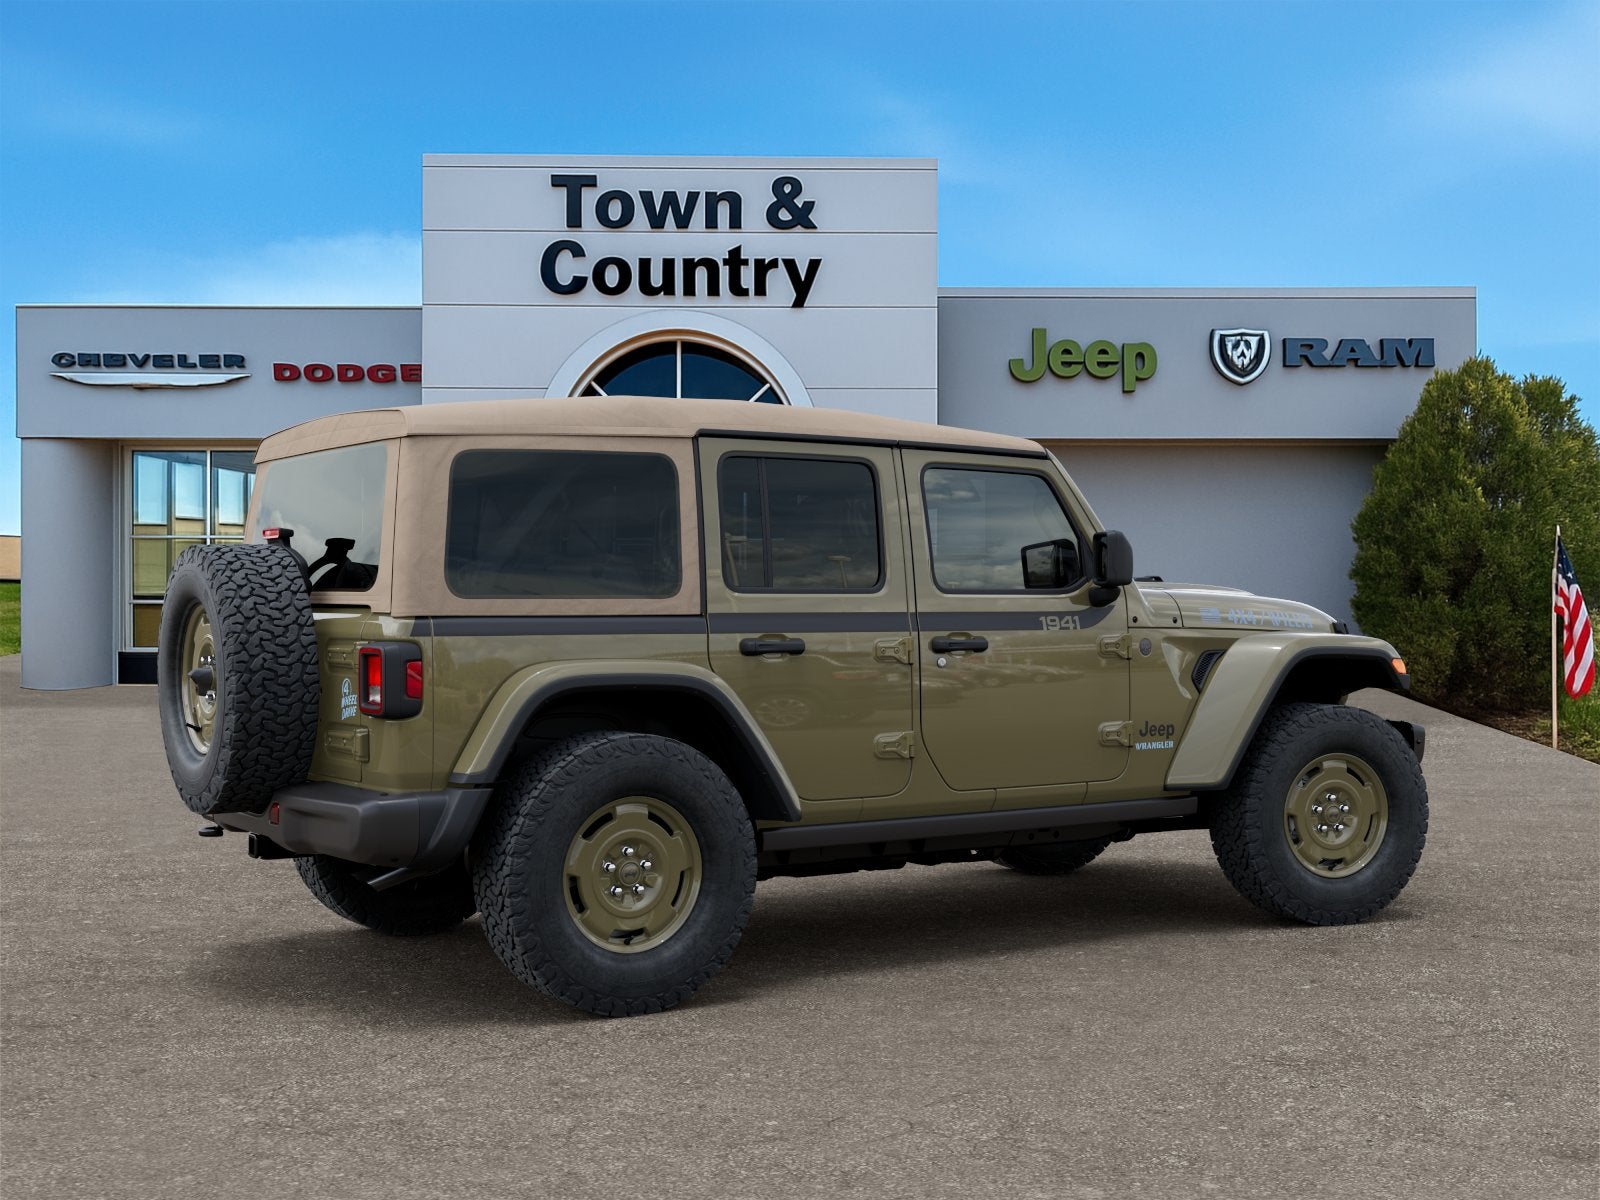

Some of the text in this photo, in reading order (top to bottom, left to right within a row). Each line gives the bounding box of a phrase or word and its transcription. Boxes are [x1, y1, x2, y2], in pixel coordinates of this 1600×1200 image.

[550, 173, 818, 229] Town &
[540, 239, 822, 308] Country
[1009, 328, 1157, 393] Jeep
[1283, 337, 1435, 368] RAM
[273, 362, 422, 383] DODGE
[1039, 615, 1081, 631] 1941
[1139, 720, 1175, 739] Jeep
[1135, 741, 1174, 750] WRANGLER
